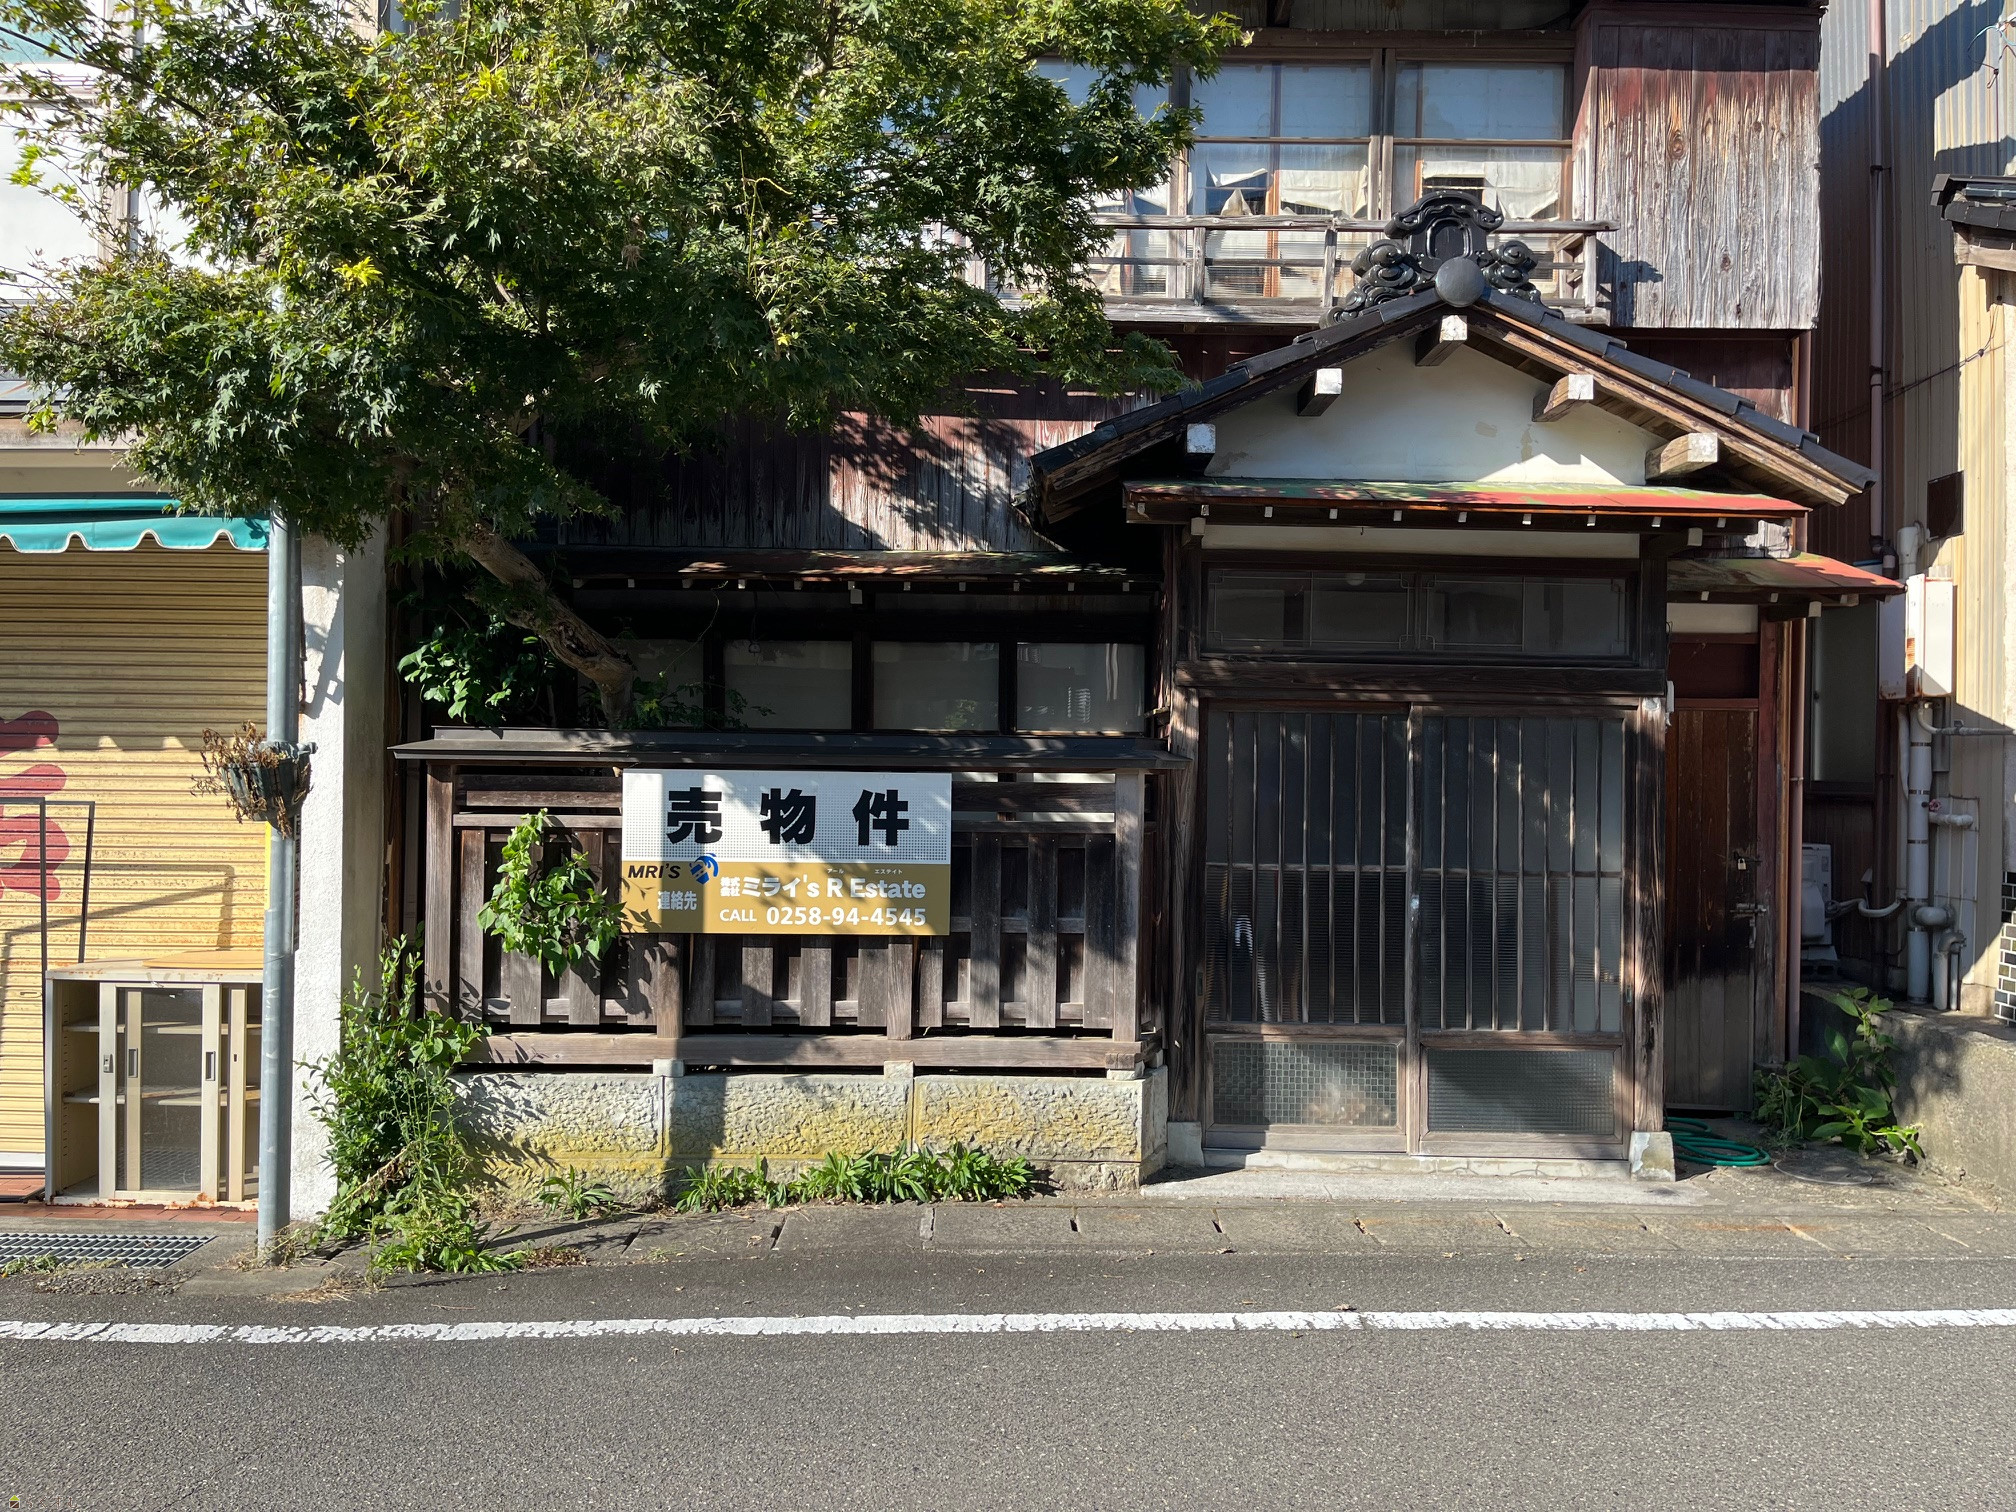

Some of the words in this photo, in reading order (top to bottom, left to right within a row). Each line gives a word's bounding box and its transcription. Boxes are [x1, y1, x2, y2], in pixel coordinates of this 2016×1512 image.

[667, 786, 910, 846] 売物件
[627, 863, 681, 879] MRI'S
[827, 877, 843, 898] R
[850, 877, 926, 899] Estate
[657, 890, 698, 911] 連絡先
[719, 908, 757, 922] CALL
[766, 906, 927, 926] 0258-94-4545
